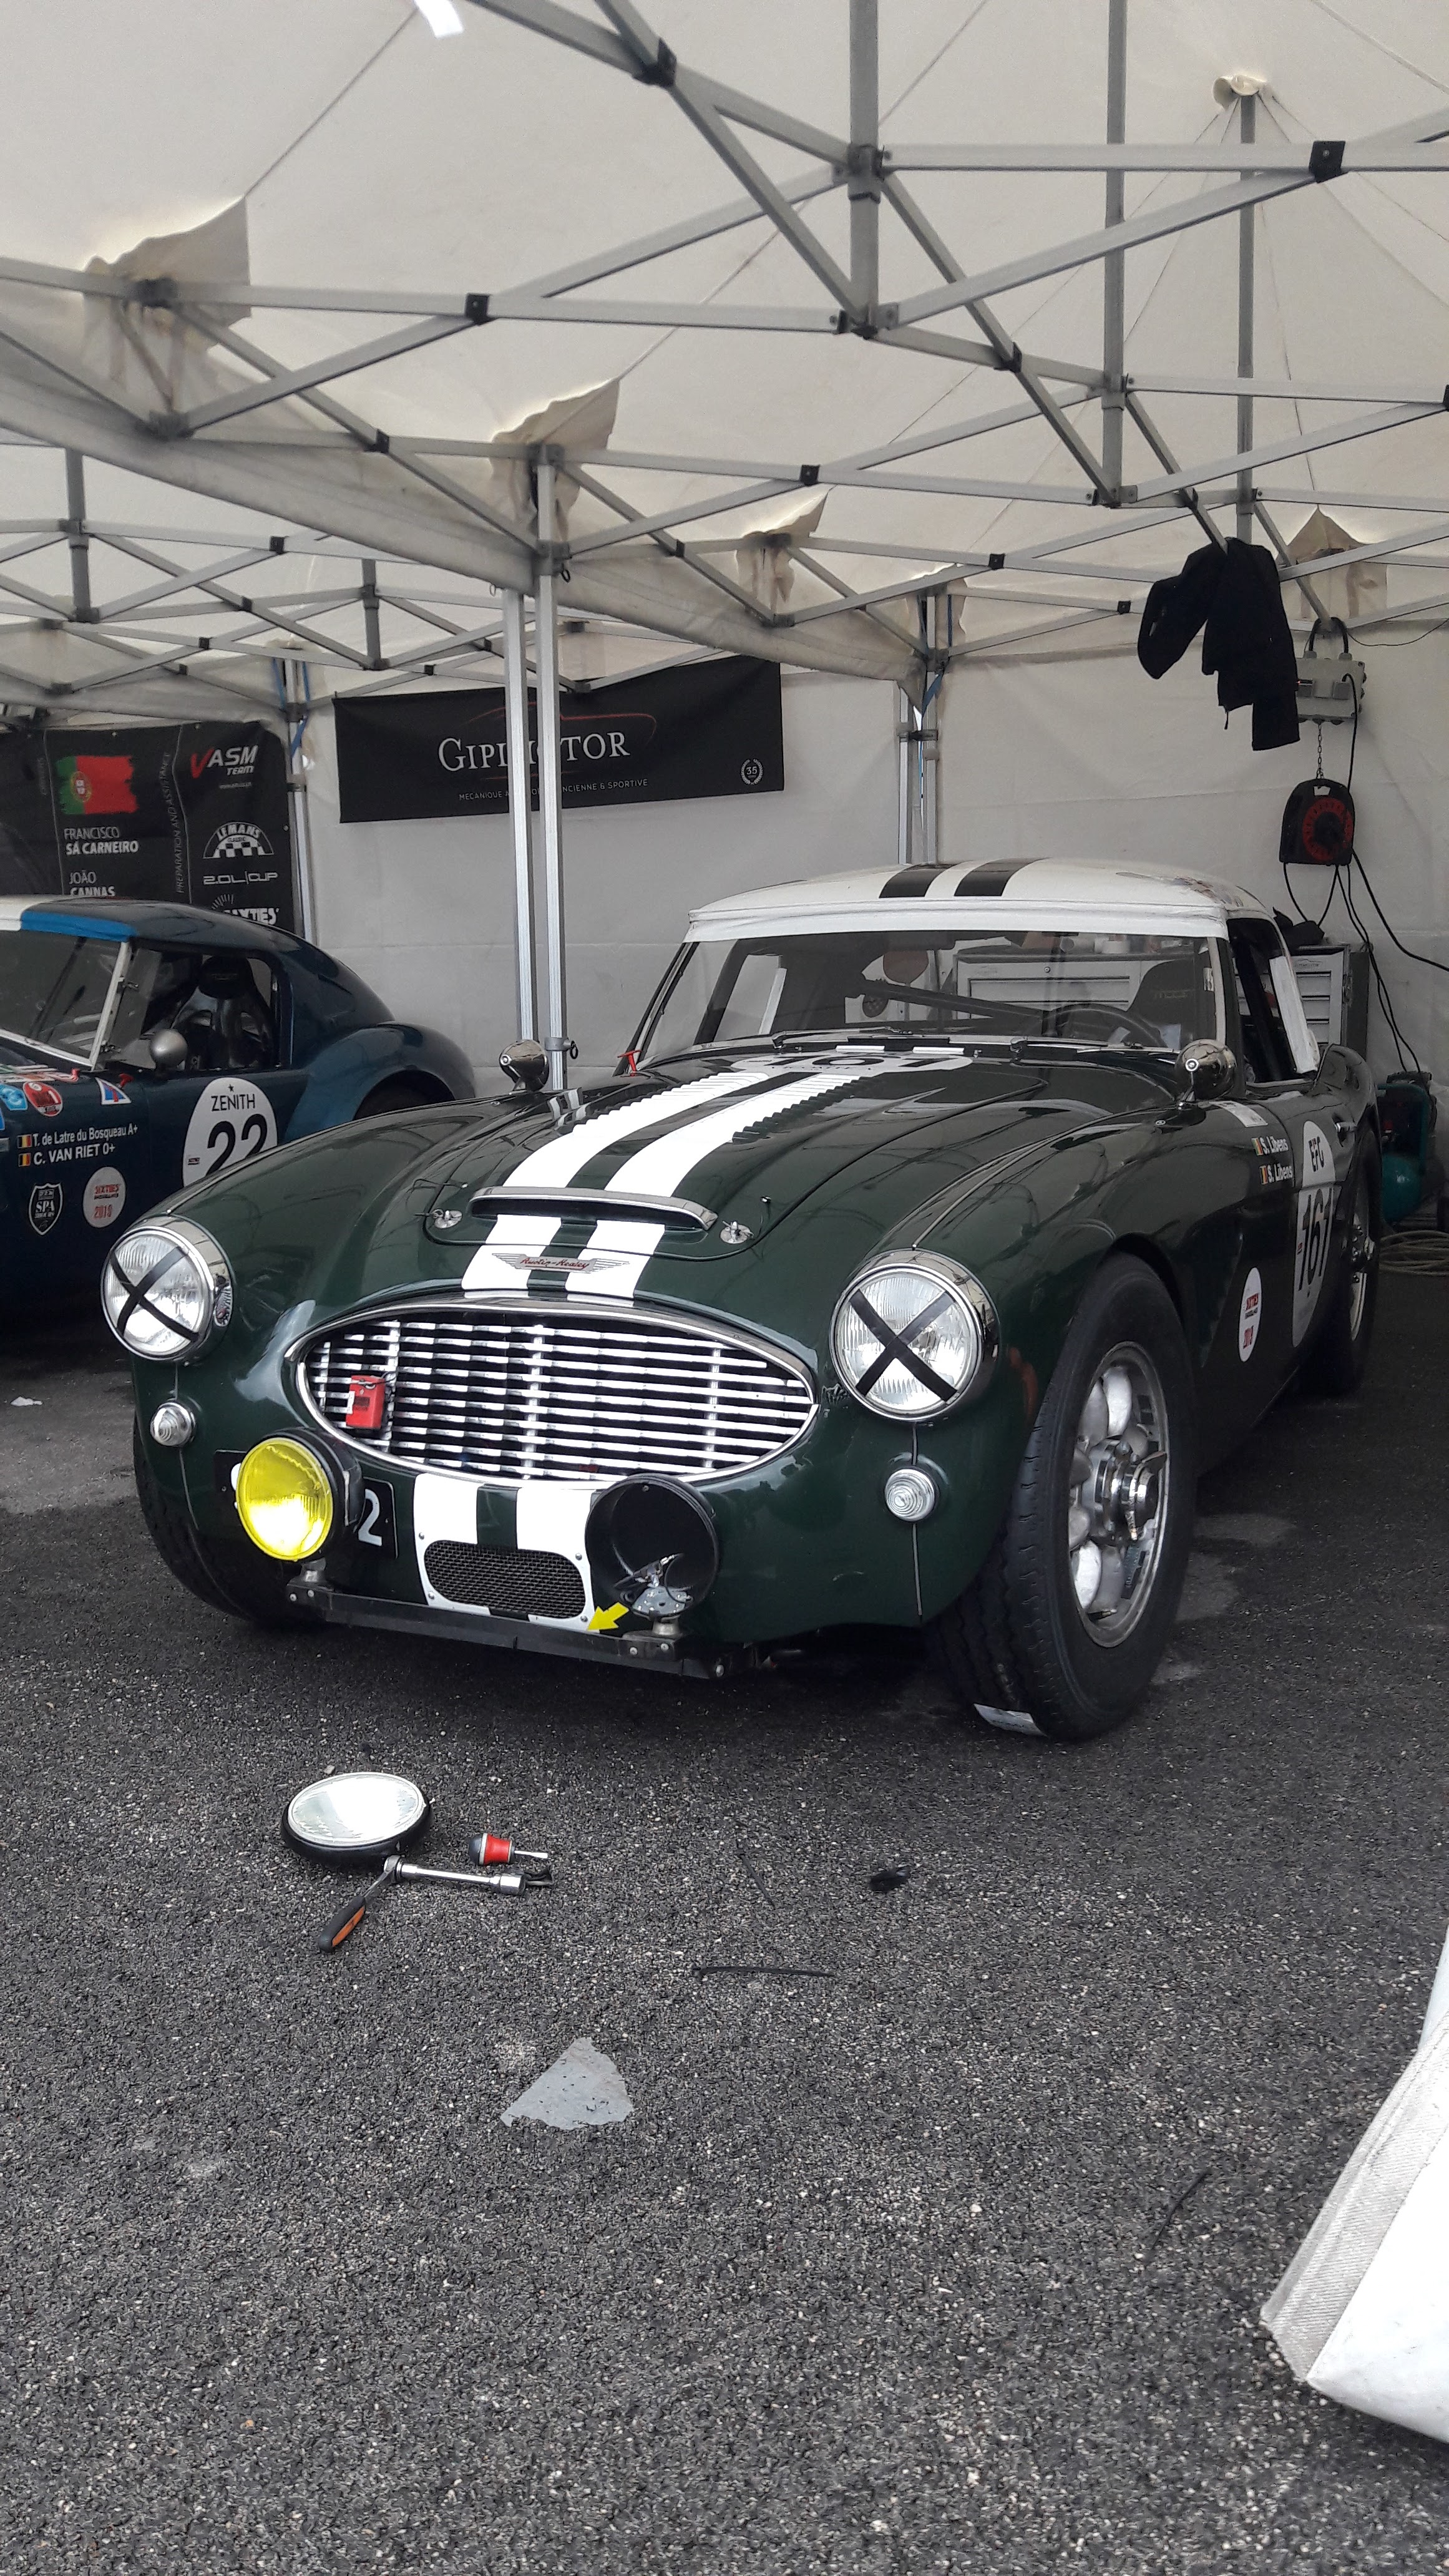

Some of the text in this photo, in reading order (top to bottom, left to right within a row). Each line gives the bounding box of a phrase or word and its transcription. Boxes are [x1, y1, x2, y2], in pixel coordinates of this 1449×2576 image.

[439, 732, 631, 772] GIPITOR
[746, 766, 758, 775] 35
[562, 782, 597, 793] NCIENNE
[608, 778, 648, 789] SPORTIVE
[64, 826, 120, 841] FRANCISCO
[82, 840, 139, 854] CARNEIRO
[210, 1093, 256, 1112] ZENITH
[42, 1132, 52, 1146] de
[54, 1131, 75, 1144] Latre
[77, 1128, 87, 1141] du
[89, 1126, 127, 1141] Bosqueau
[128, 1123, 138, 1136] A+
[33, 1151, 46, 1165] C.
[49, 1148, 72, 1163] VAN
[76, 1143, 100, 1159] RIET
[207, 1113, 268, 1176] 22
[36, 1200, 55, 1212] SPA
[1298, 1188, 1333, 1291] 161
